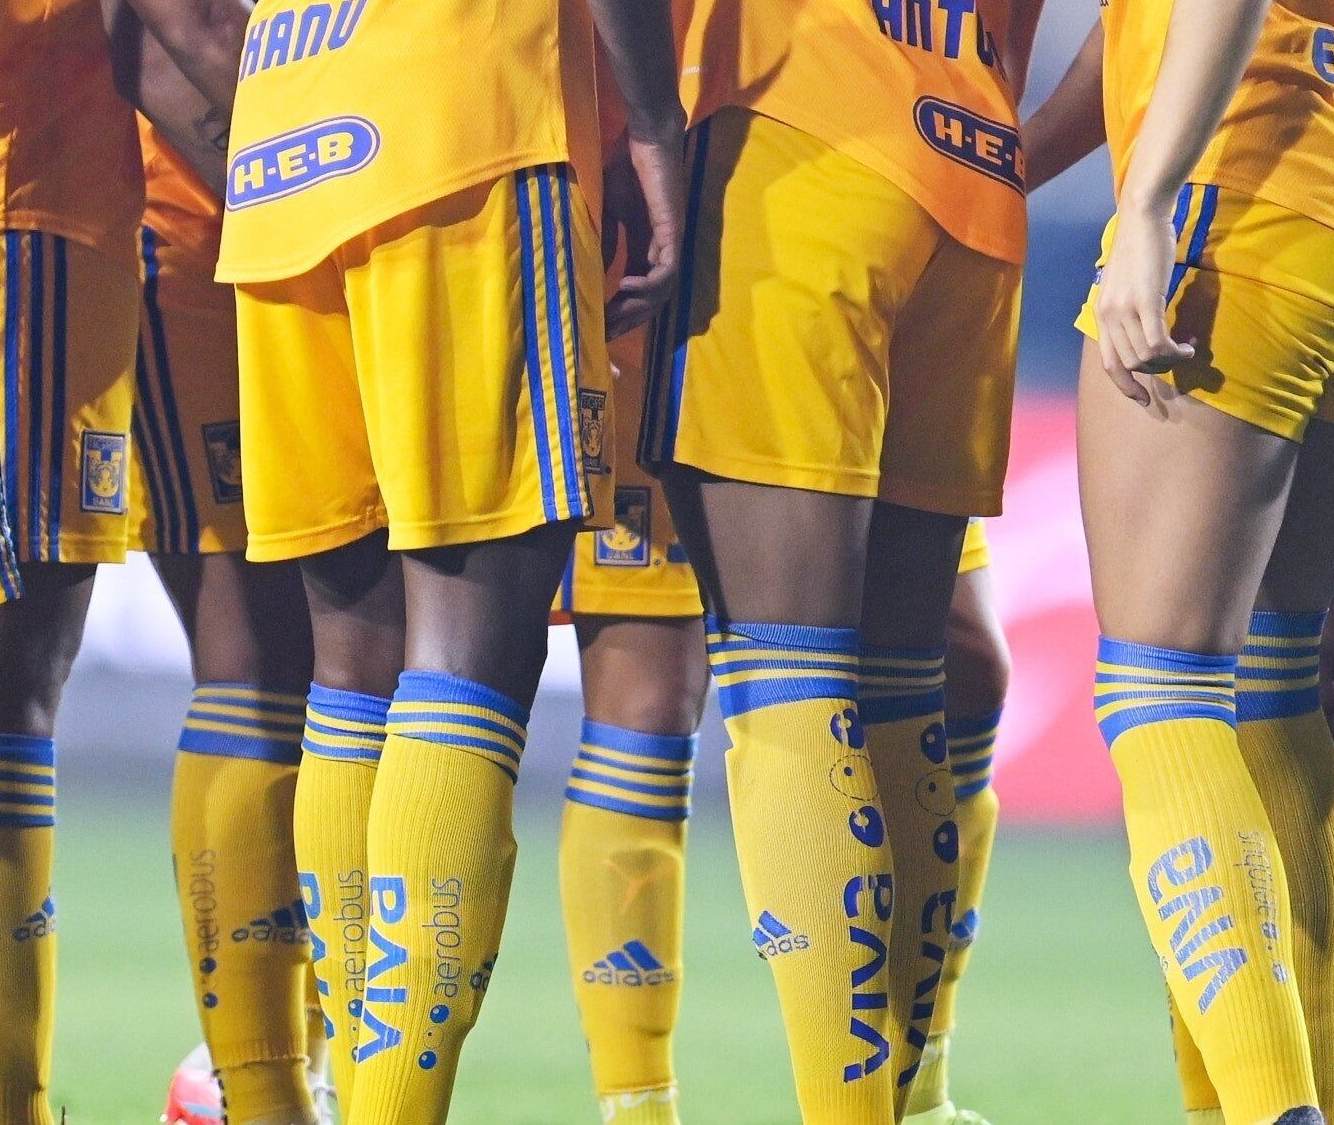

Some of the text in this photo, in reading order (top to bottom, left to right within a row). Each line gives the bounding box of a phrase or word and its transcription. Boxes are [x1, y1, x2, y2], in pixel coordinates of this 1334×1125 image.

[333, 869, 367, 994] aerobus
[422, 877, 462, 998] aerobus
[582, 968, 675, 986] adidas
